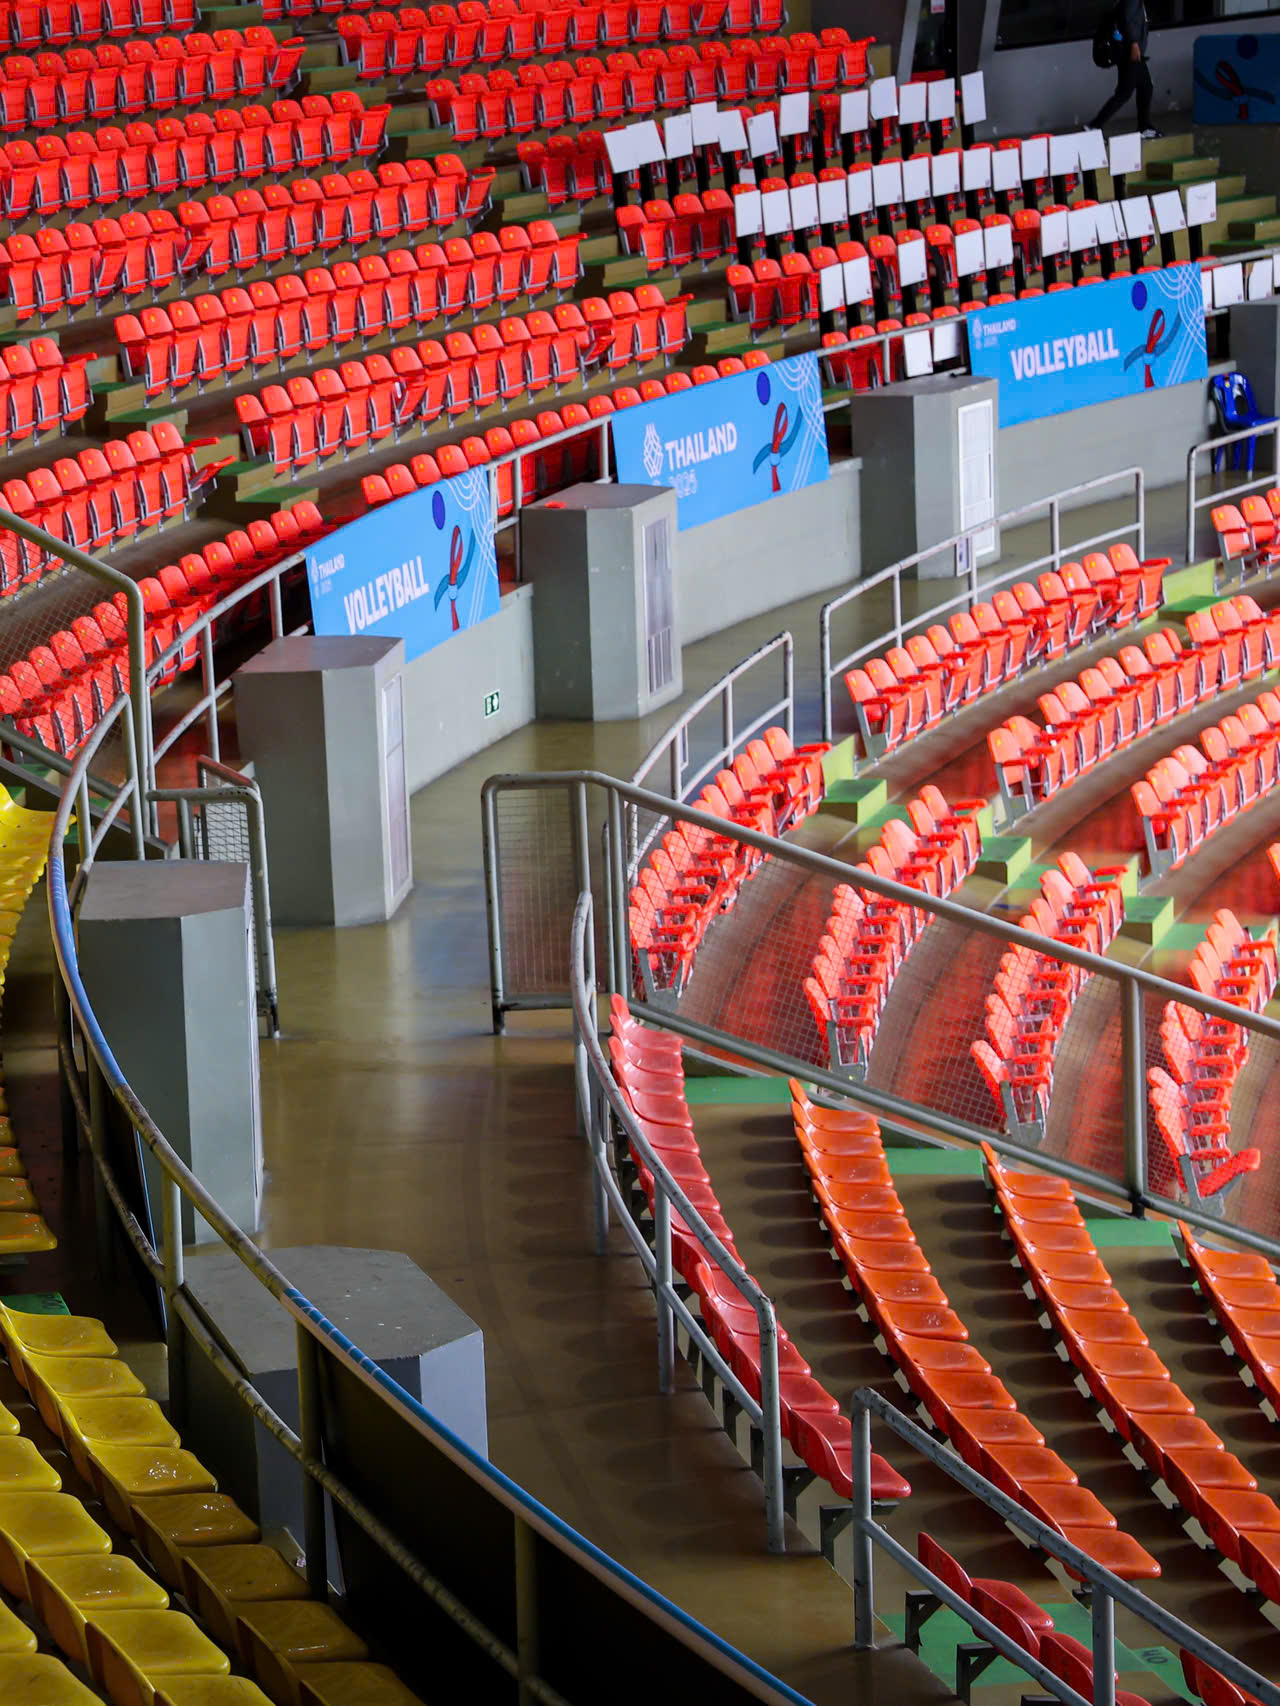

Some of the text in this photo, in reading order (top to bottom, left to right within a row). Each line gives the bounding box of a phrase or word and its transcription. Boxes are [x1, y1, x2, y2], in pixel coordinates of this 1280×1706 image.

[1010, 328, 1119, 381] VOLLEYBALL
[664, 422, 738, 472] THAILAND
[344, 555, 429, 636] VOLLEYBALL
